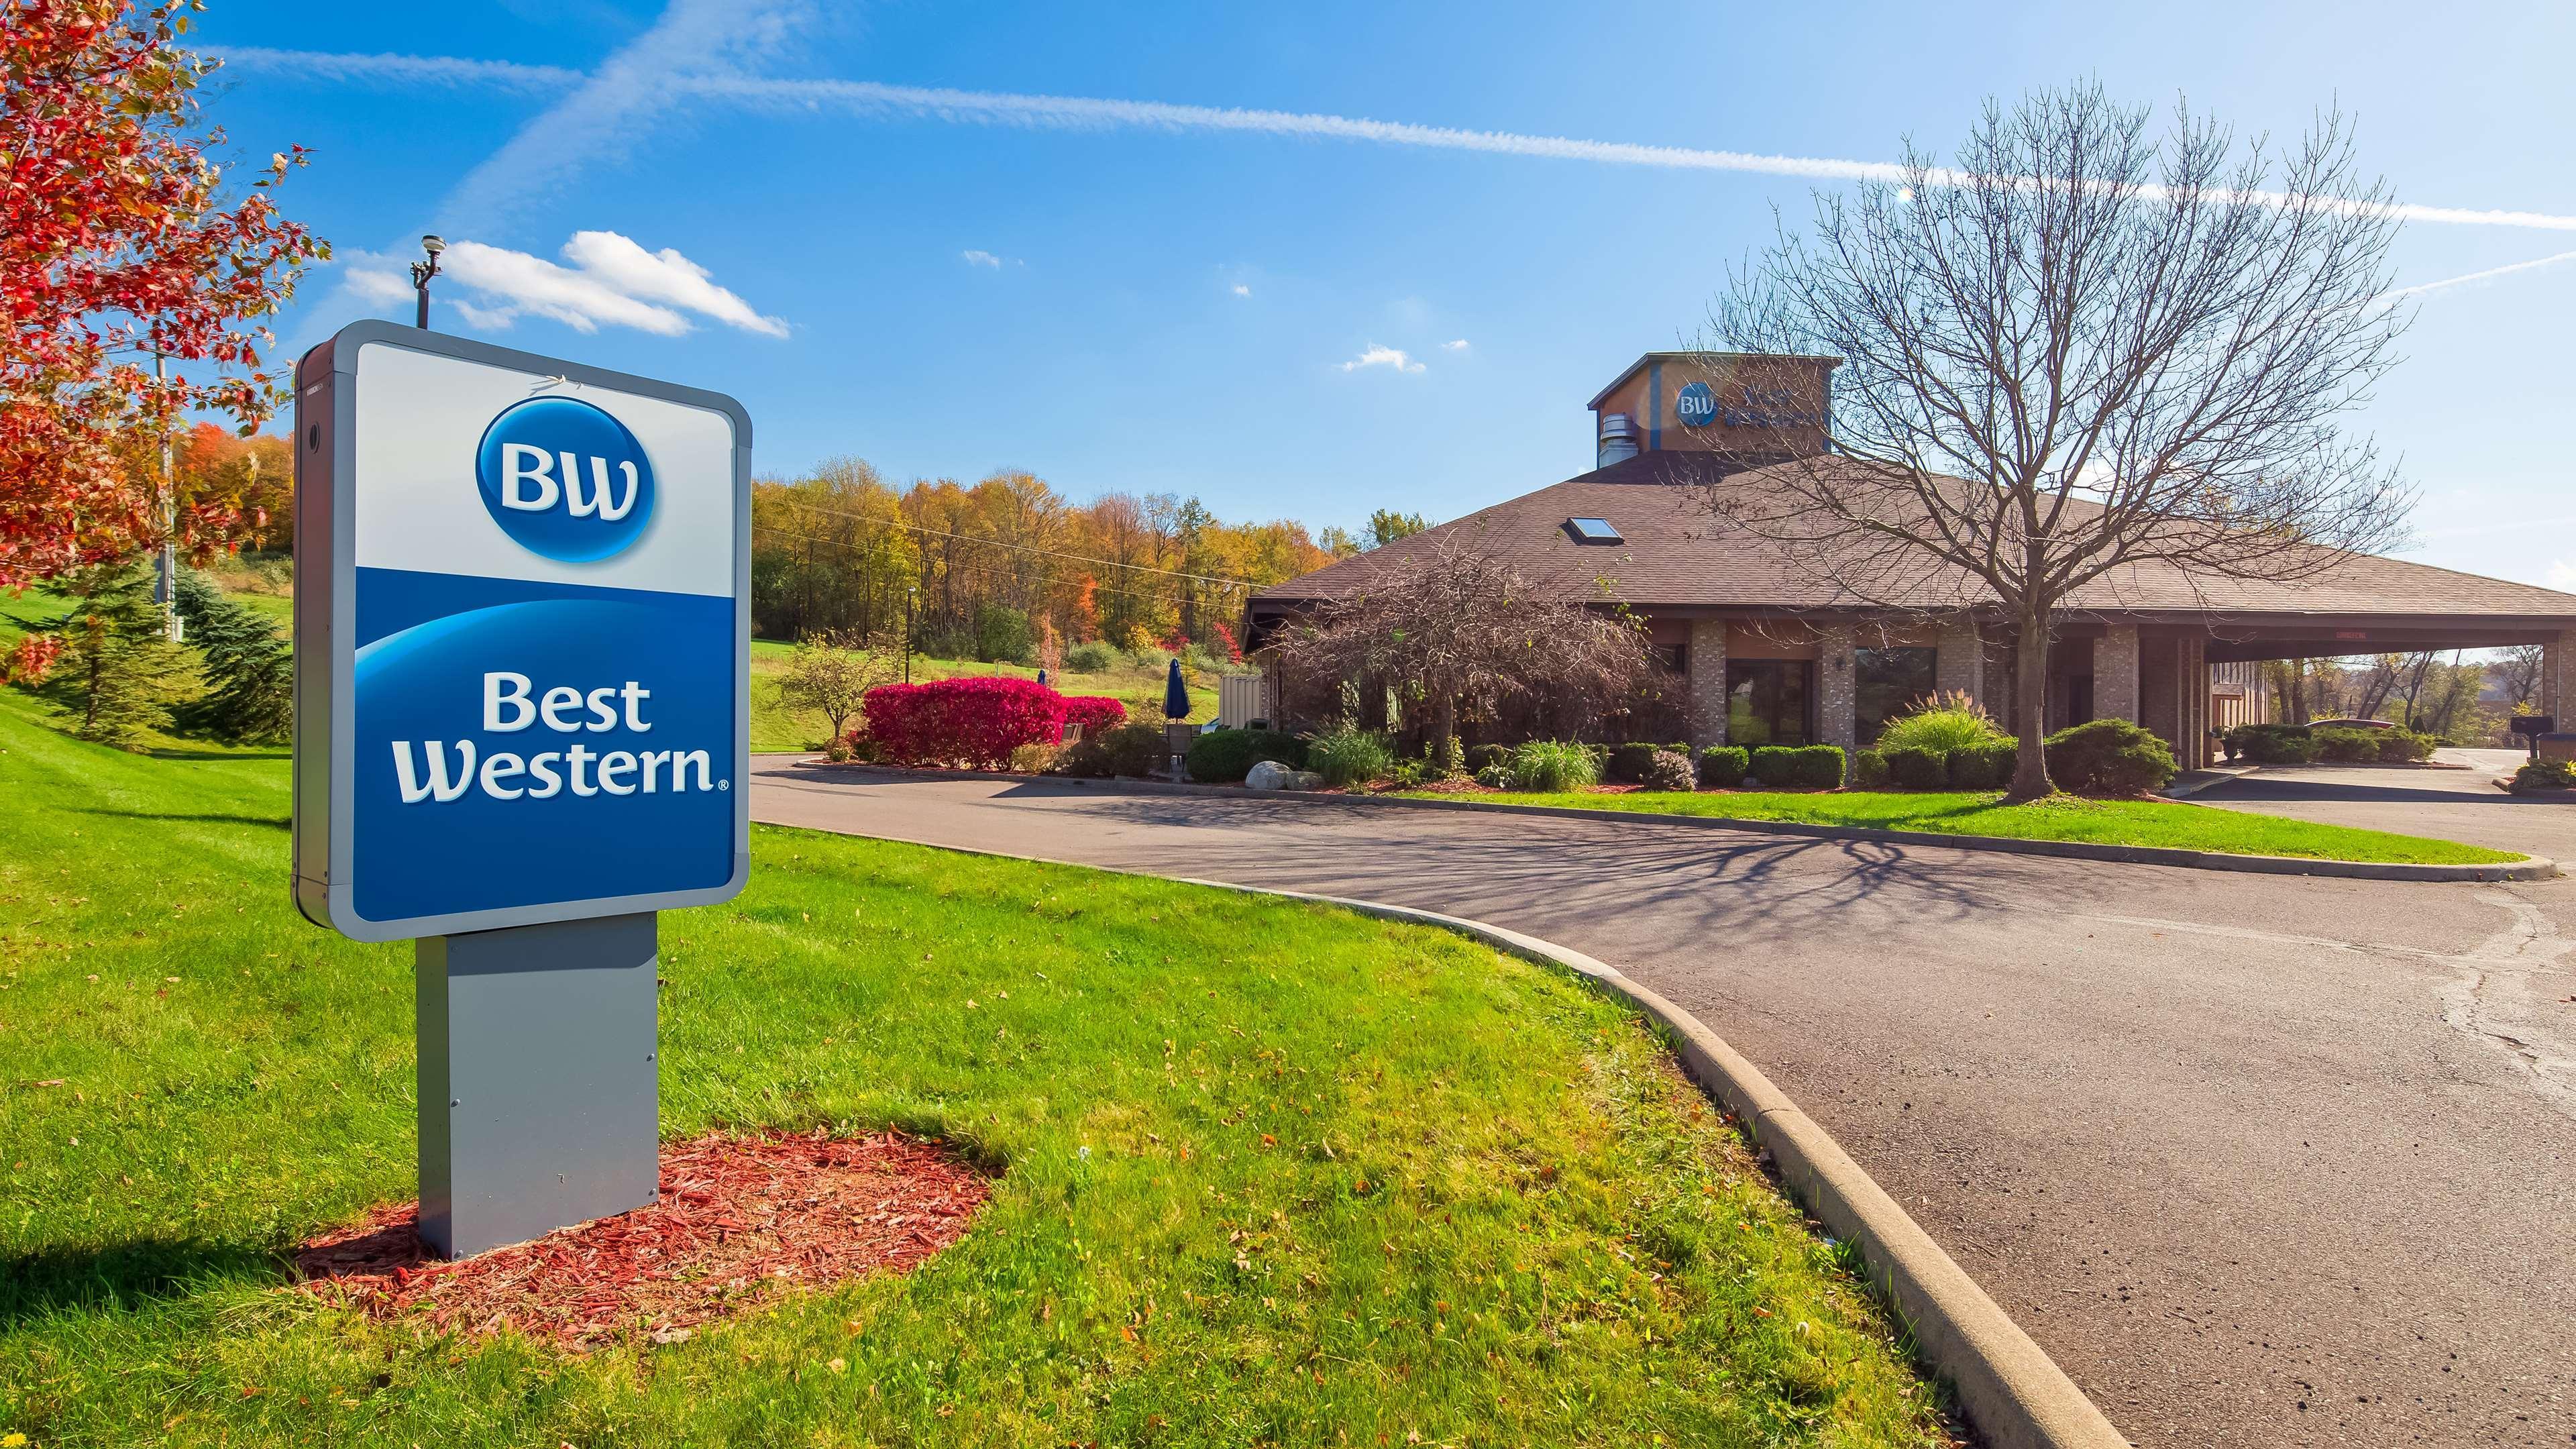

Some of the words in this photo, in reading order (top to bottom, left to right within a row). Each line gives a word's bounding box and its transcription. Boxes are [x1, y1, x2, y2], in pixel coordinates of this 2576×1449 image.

[1680, 396, 1714, 415] BW
[502, 443, 638, 521] BW
[483, 672, 651, 733] Best
